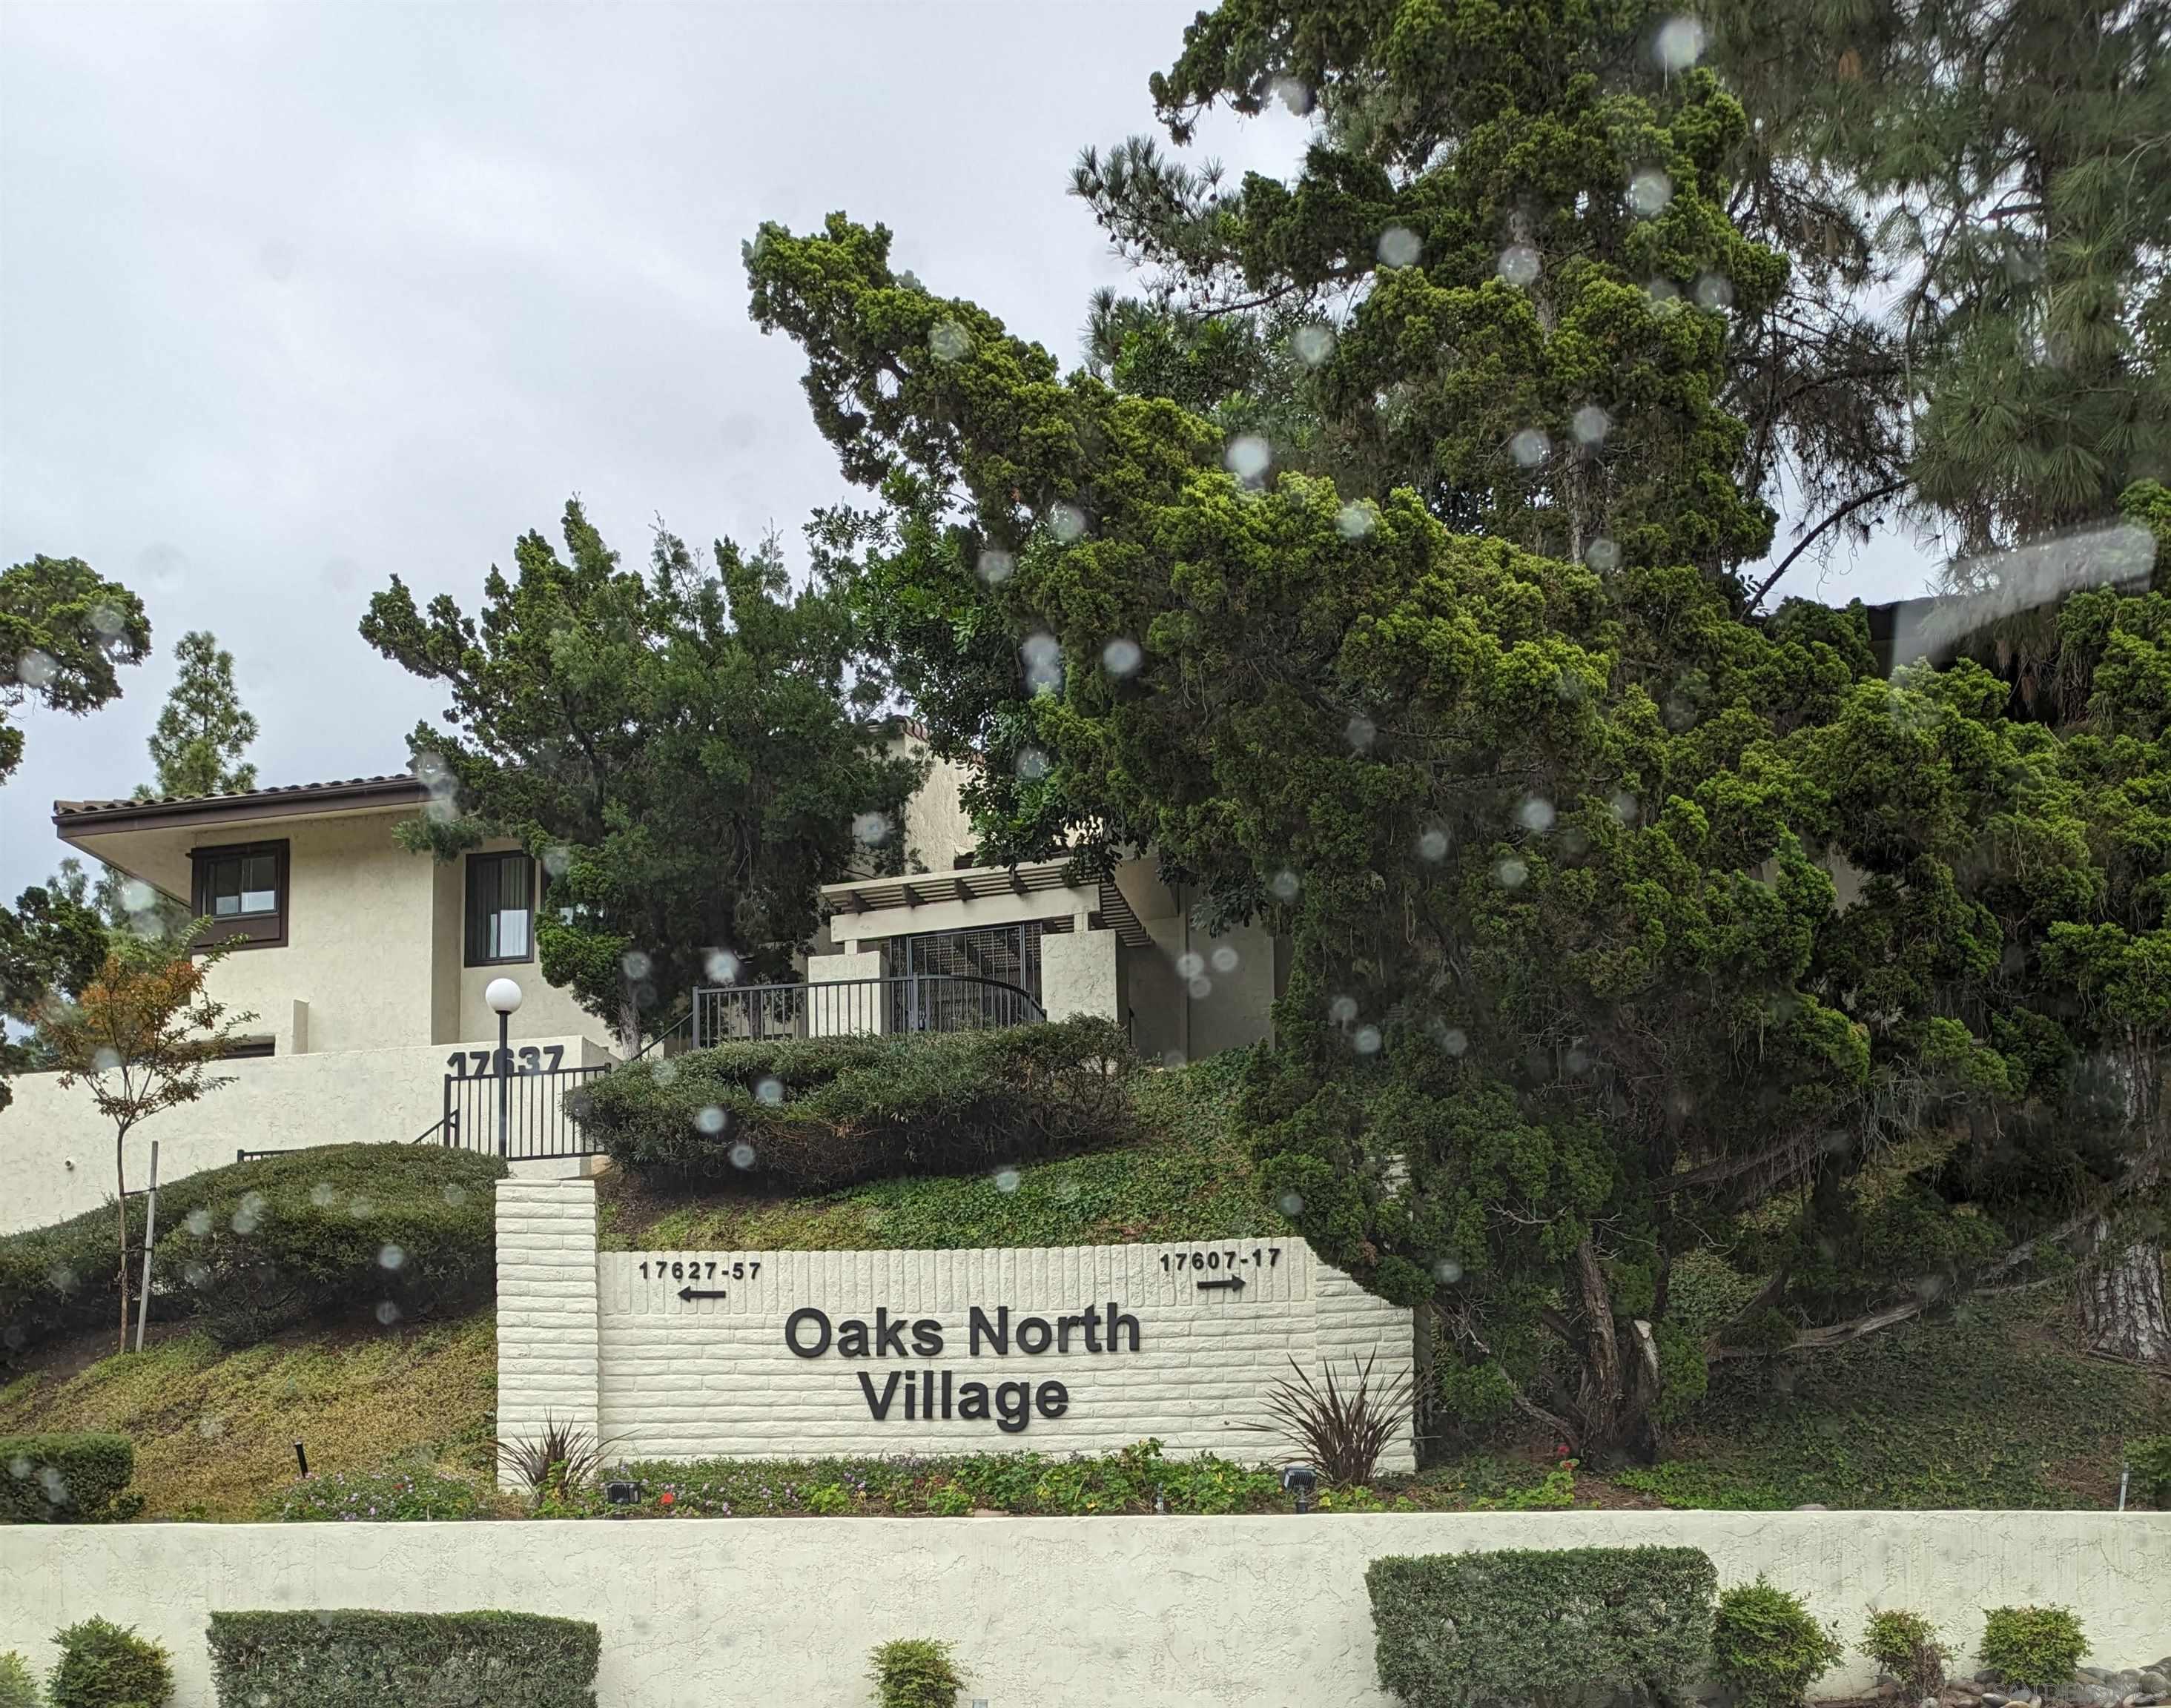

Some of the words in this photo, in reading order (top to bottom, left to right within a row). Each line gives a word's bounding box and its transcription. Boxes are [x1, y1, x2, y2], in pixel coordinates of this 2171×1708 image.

[639, 1261, 760, 1280] 17627-57
[1160, 1248, 1281, 1271] 17607-17
[784, 1307, 944, 1358] Oaks
[969, 1302, 1140, 1355] North
[857, 1370, 1069, 1432] Village
